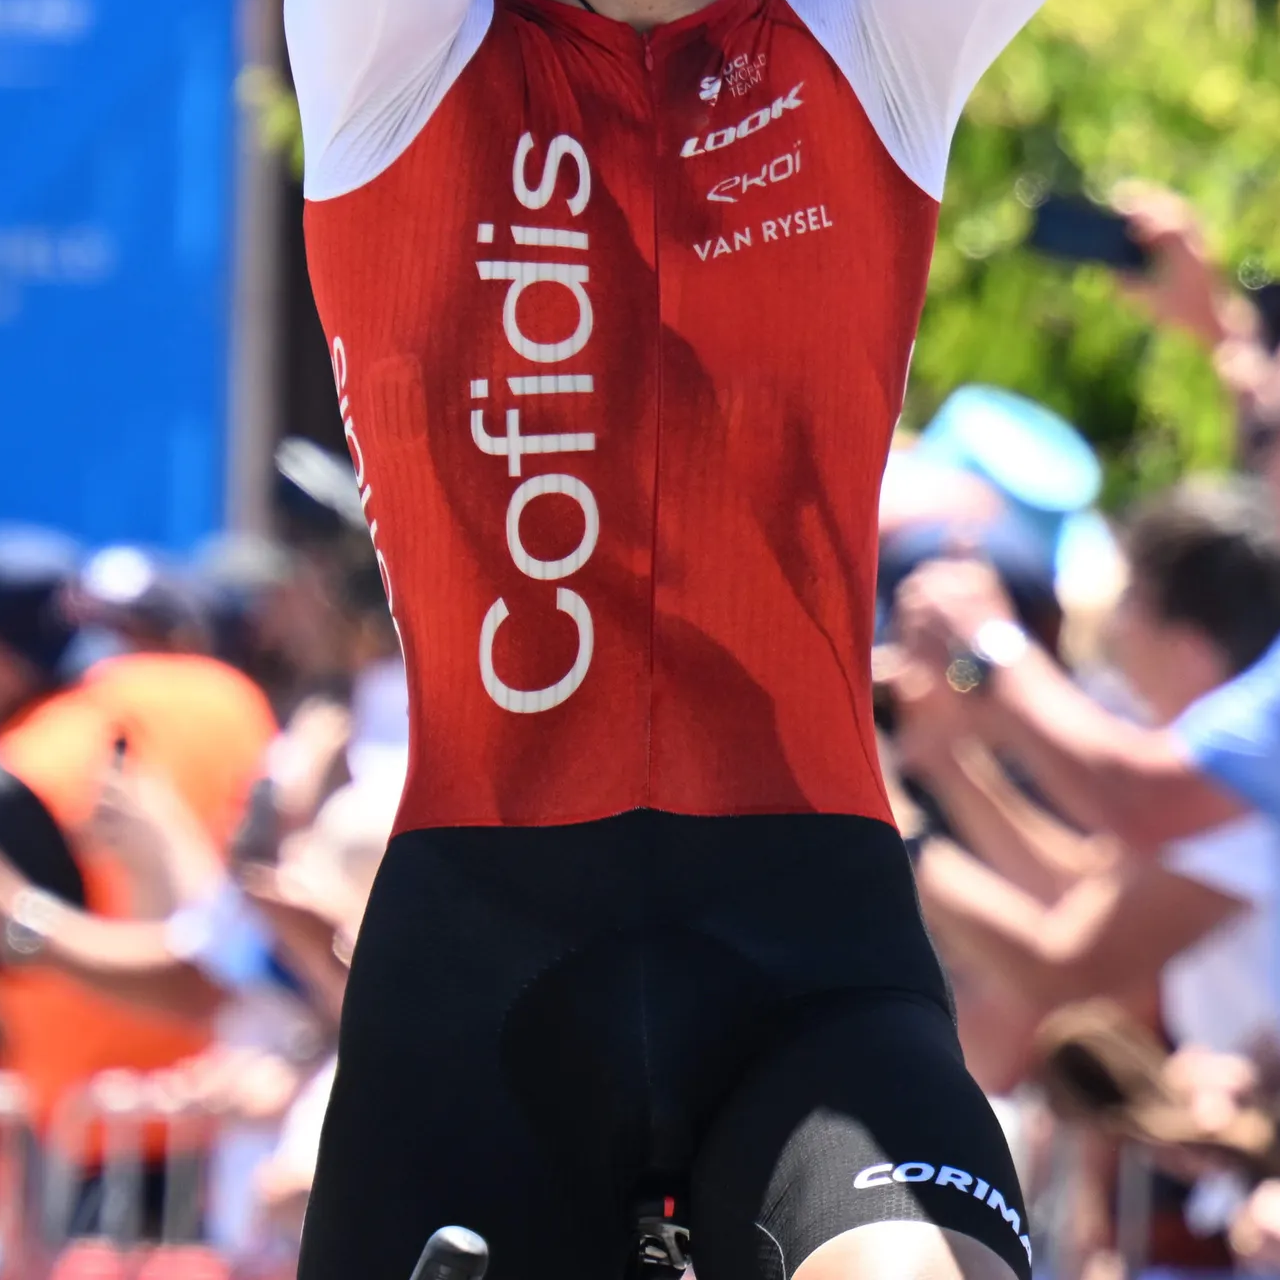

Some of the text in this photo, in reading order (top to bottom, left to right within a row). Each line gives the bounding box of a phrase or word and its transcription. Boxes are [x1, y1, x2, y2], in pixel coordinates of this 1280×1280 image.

[729, 70, 762, 98] TEAM
[680, 81, 805, 158] LOOK
[693, 205, 833, 261] VAN RYSEL
[471, 131, 600, 714] Cofidis
